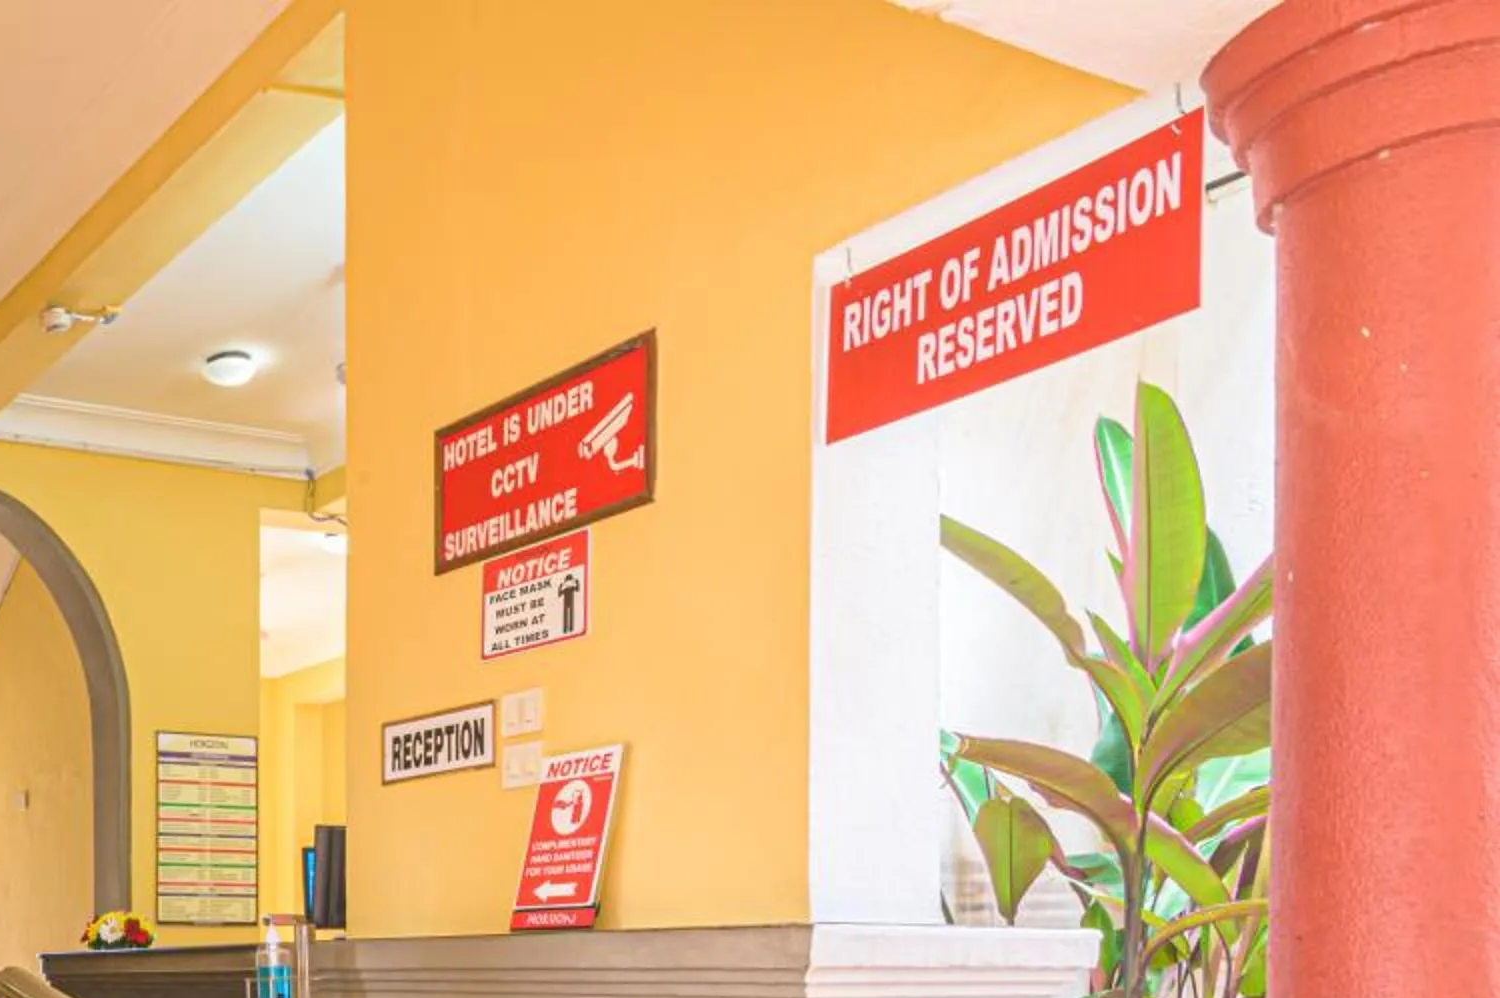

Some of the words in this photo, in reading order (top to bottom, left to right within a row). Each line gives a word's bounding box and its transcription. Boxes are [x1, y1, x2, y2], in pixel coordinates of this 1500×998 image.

[843, 269, 933, 352] RIGHT
[939, 246, 981, 311] OF
[987, 151, 1182, 292] ADMISSION
[916, 270, 1084, 385] RESERVED
[443, 425, 497, 472] HOTEL
[503, 412, 521, 446] IS
[527, 380, 594, 435] UNDER
[491, 452, 539, 498] CCTV
[444, 488, 578, 561] SURVEILLANCE
[496, 546, 572, 589] NOTICE
[489, 589, 517, 605] FACE
[519, 579, 553, 597] MASK
[495, 602, 526, 619] MUST
[529, 597, 545, 609] BE
[491, 639, 511, 652] ALL
[514, 630, 549, 647] TIMES
[494, 618, 528, 635] WORN
[531, 613, 546, 625] AT
[391, 717, 485, 773] RECEPTION
[547, 751, 613, 778] NOTICE
[524, 866, 541, 877] FOR
[542, 865, 565, 876] YOUR
